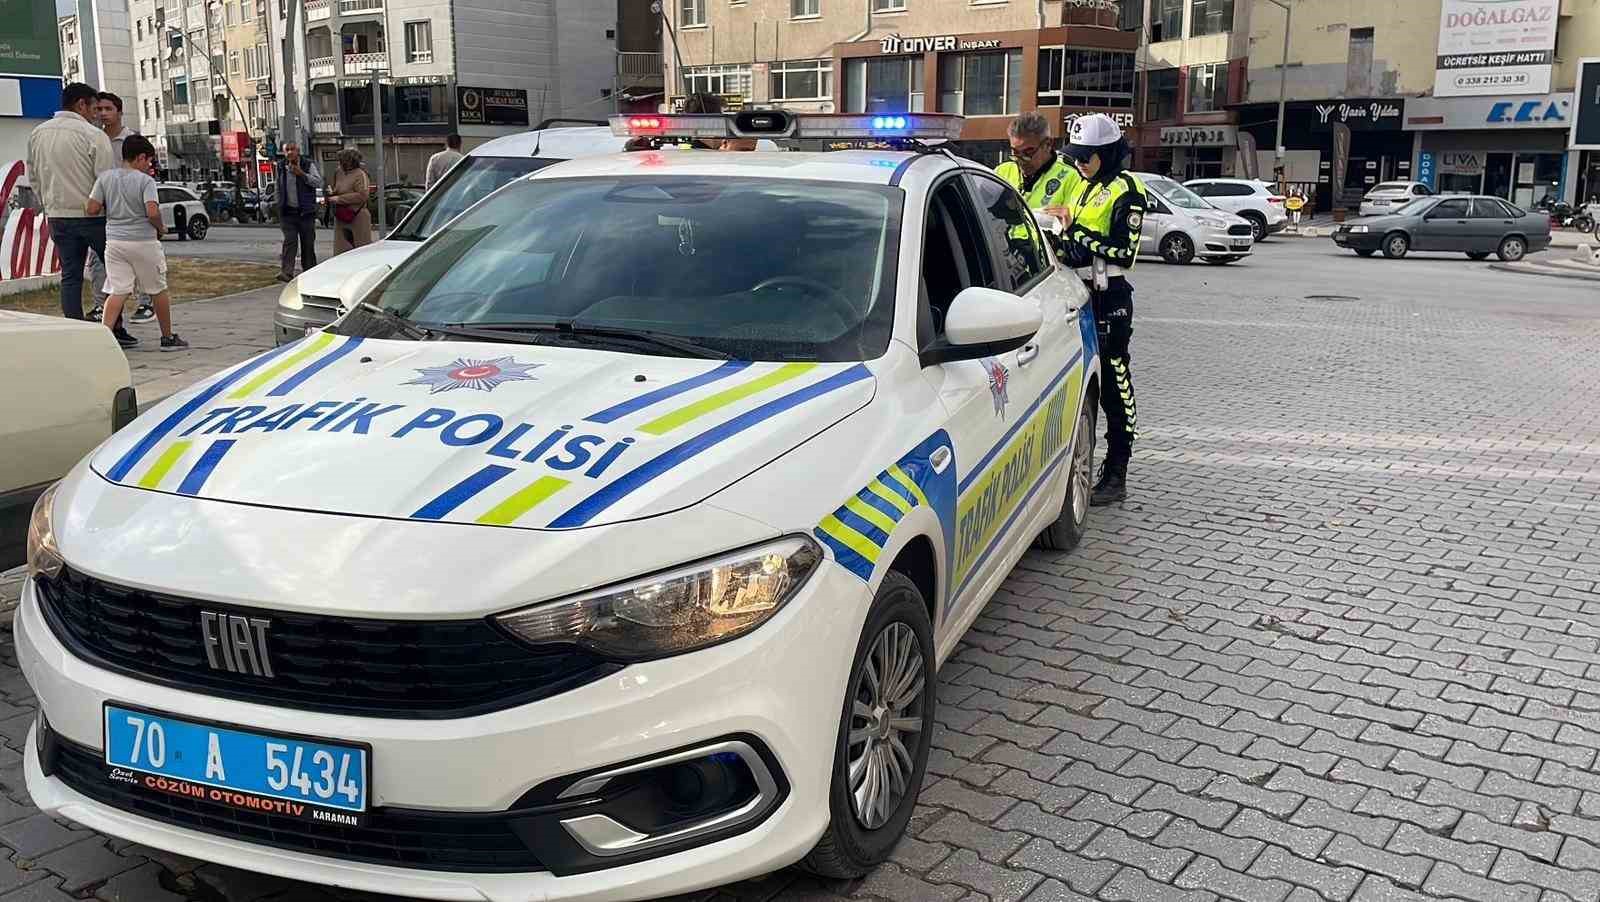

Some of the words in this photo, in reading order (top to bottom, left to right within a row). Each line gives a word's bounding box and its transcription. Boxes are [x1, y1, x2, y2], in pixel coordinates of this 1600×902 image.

[1446, 7, 1551, 28] DOĞALGAZ
[1444, 54, 1487, 66] ÜCRETSİZ
[1488, 53, 1515, 65] KEŞİF
[1517, 52, 1545, 63] HATTI
[1483, 76, 1499, 84] 212
[178, 397, 406, 437] TRAFİK
[391, 407, 636, 479] POLİSİ
[957, 471, 1001, 571] TRAFİK
[200, 610, 275, 678] FIAT
[127, 716, 166, 768] 70
[204, 732, 226, 781] A
[265, 742, 359, 803] 5434
[209, 790, 305, 816] OTOMOTİV
[313, 810, 358, 826] KARAMAN
